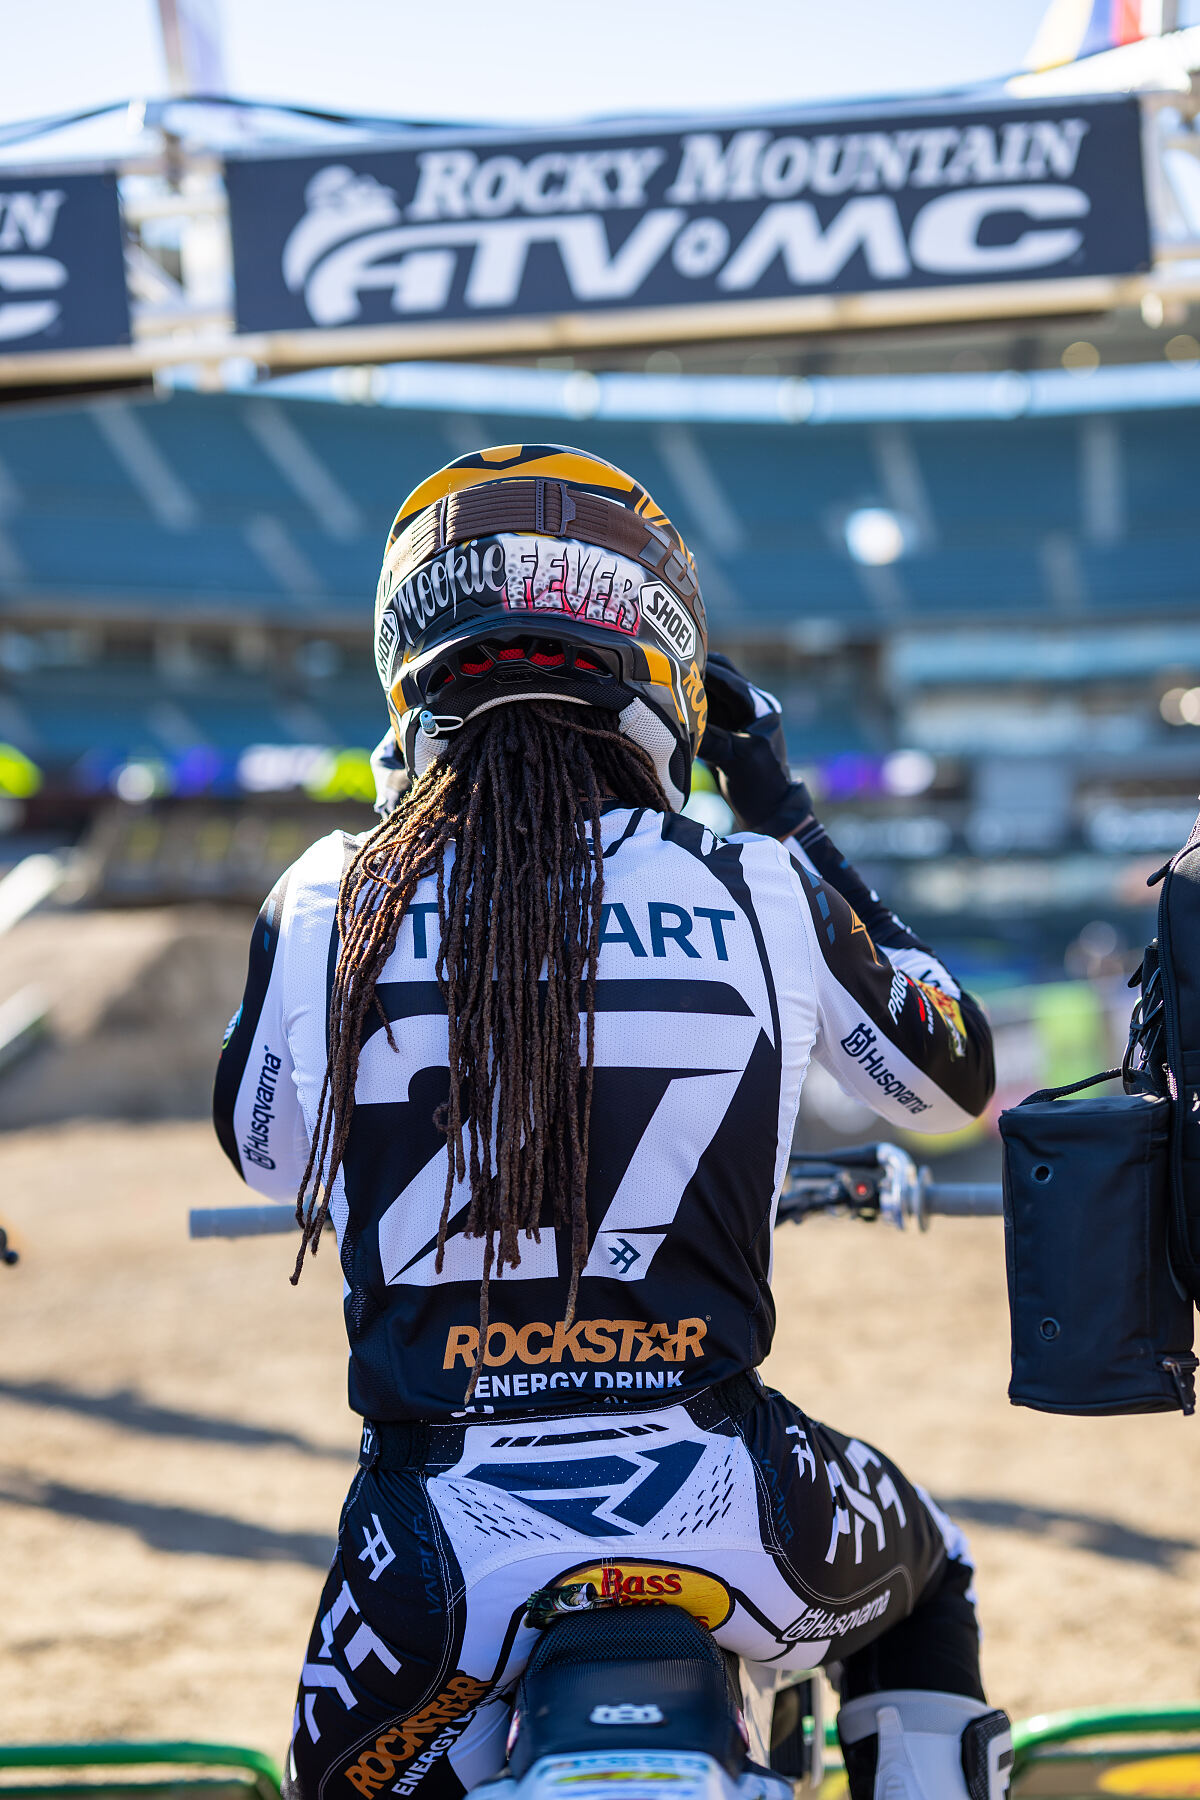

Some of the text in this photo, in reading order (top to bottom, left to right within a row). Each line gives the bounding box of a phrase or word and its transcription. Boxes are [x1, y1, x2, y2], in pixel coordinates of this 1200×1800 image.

[392, 536, 644, 646] Mookie FEVER
[646, 590, 692, 652] SHOEI
[248, 1052, 282, 1154] Husqvarna
[857, 1047, 926, 1115] Husqvarna
[355, 1010, 757, 1287] 27
[443, 1317, 708, 1370] ROCKSTAR
[474, 1369, 685, 1398] ENERGY DRINK
[601, 1567, 683, 1597] Bass
[807, 1589, 891, 1639] Husqvarna
[344, 1676, 494, 1800] ROCKSTAR
[391, 1726, 461, 1796] ENERGY
